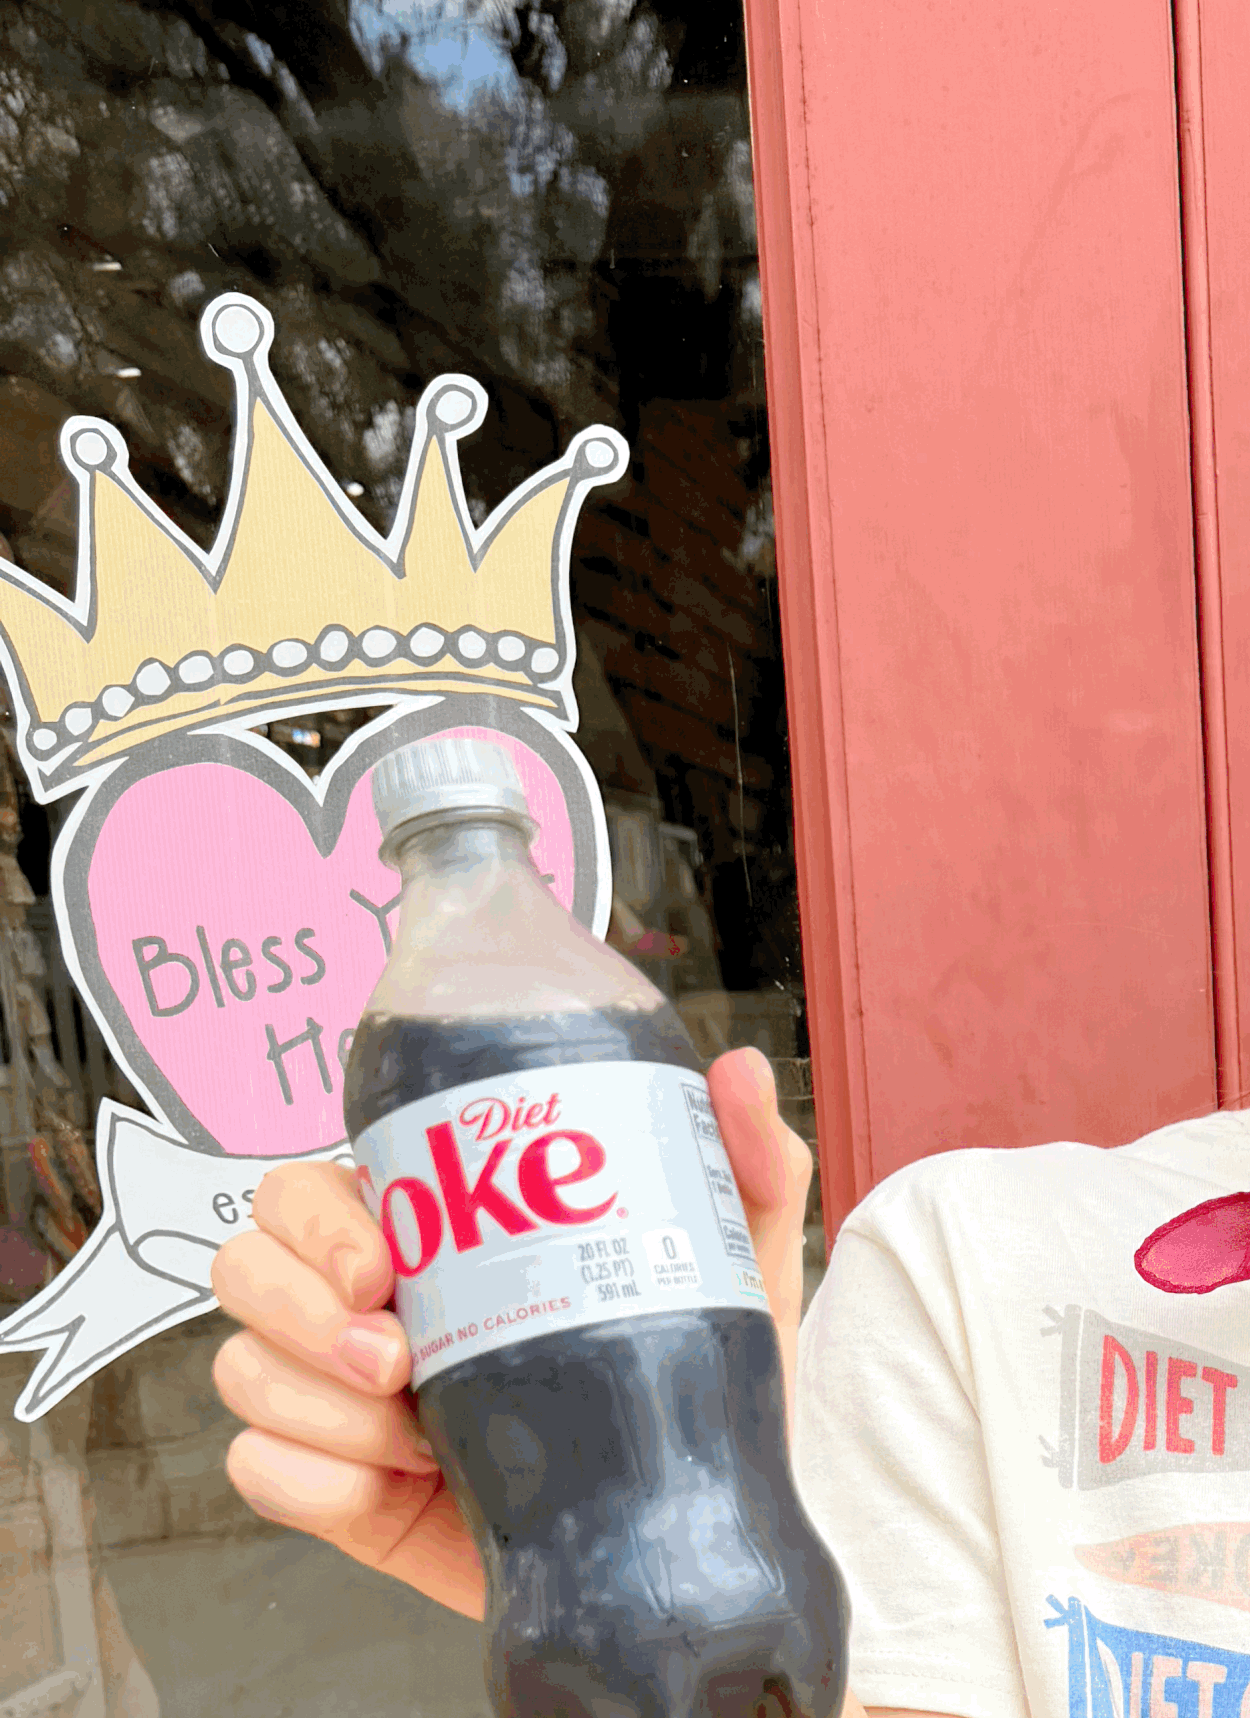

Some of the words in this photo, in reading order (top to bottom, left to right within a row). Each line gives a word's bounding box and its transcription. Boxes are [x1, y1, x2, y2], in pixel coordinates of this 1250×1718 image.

[132, 925, 326, 1017] Bless
[459, 1093, 561, 1142] Diet
[357, 1121, 620, 1279] oke
[578, 1243, 595, 1262] 20
[596, 1240, 611, 1258] FL
[613, 1238, 630, 1256] OZ
[661, 1234, 678, 1260] 0
[581, 1262, 613, 1284] (1.25
[613, 1258, 634, 1280] PT)
[653, 1261, 696, 1275] CALORIES
[598, 1282, 620, 1302] 591
[420, 1332, 455, 1362] SUGAR
[456, 1322, 479, 1343] NO
[483, 1296, 572, 1332] CALORIES
[1099, 1334, 1238, 1465] DIET
